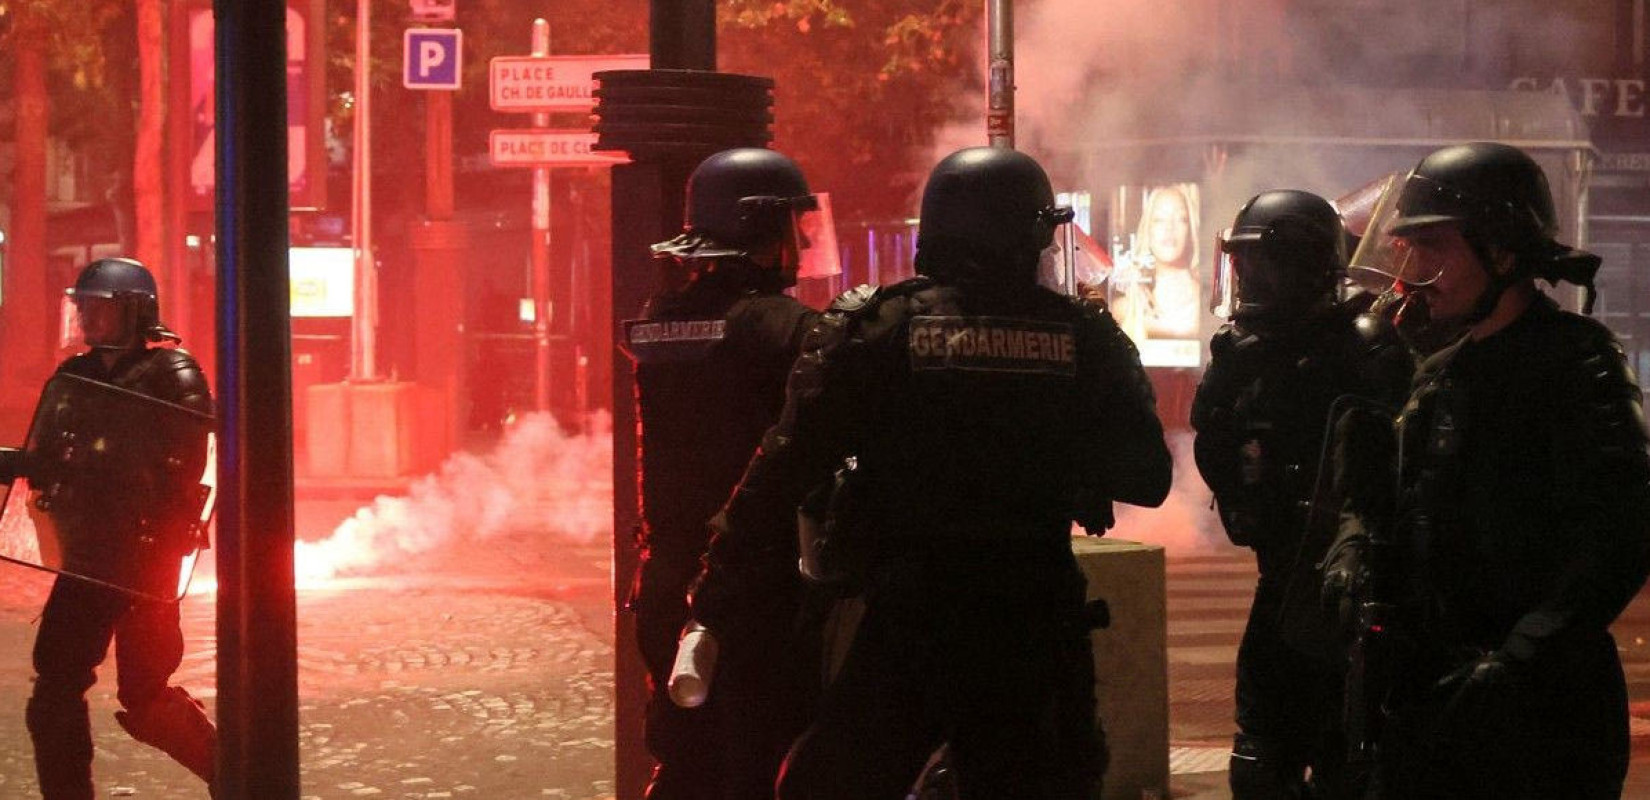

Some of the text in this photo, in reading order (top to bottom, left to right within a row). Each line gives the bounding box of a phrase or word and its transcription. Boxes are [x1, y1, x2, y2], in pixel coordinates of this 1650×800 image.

[420, 41, 446, 77] P
[501, 67, 553, 80] PLACE
[526, 86, 541, 98] DE
[547, 86, 593, 98] GAULL
